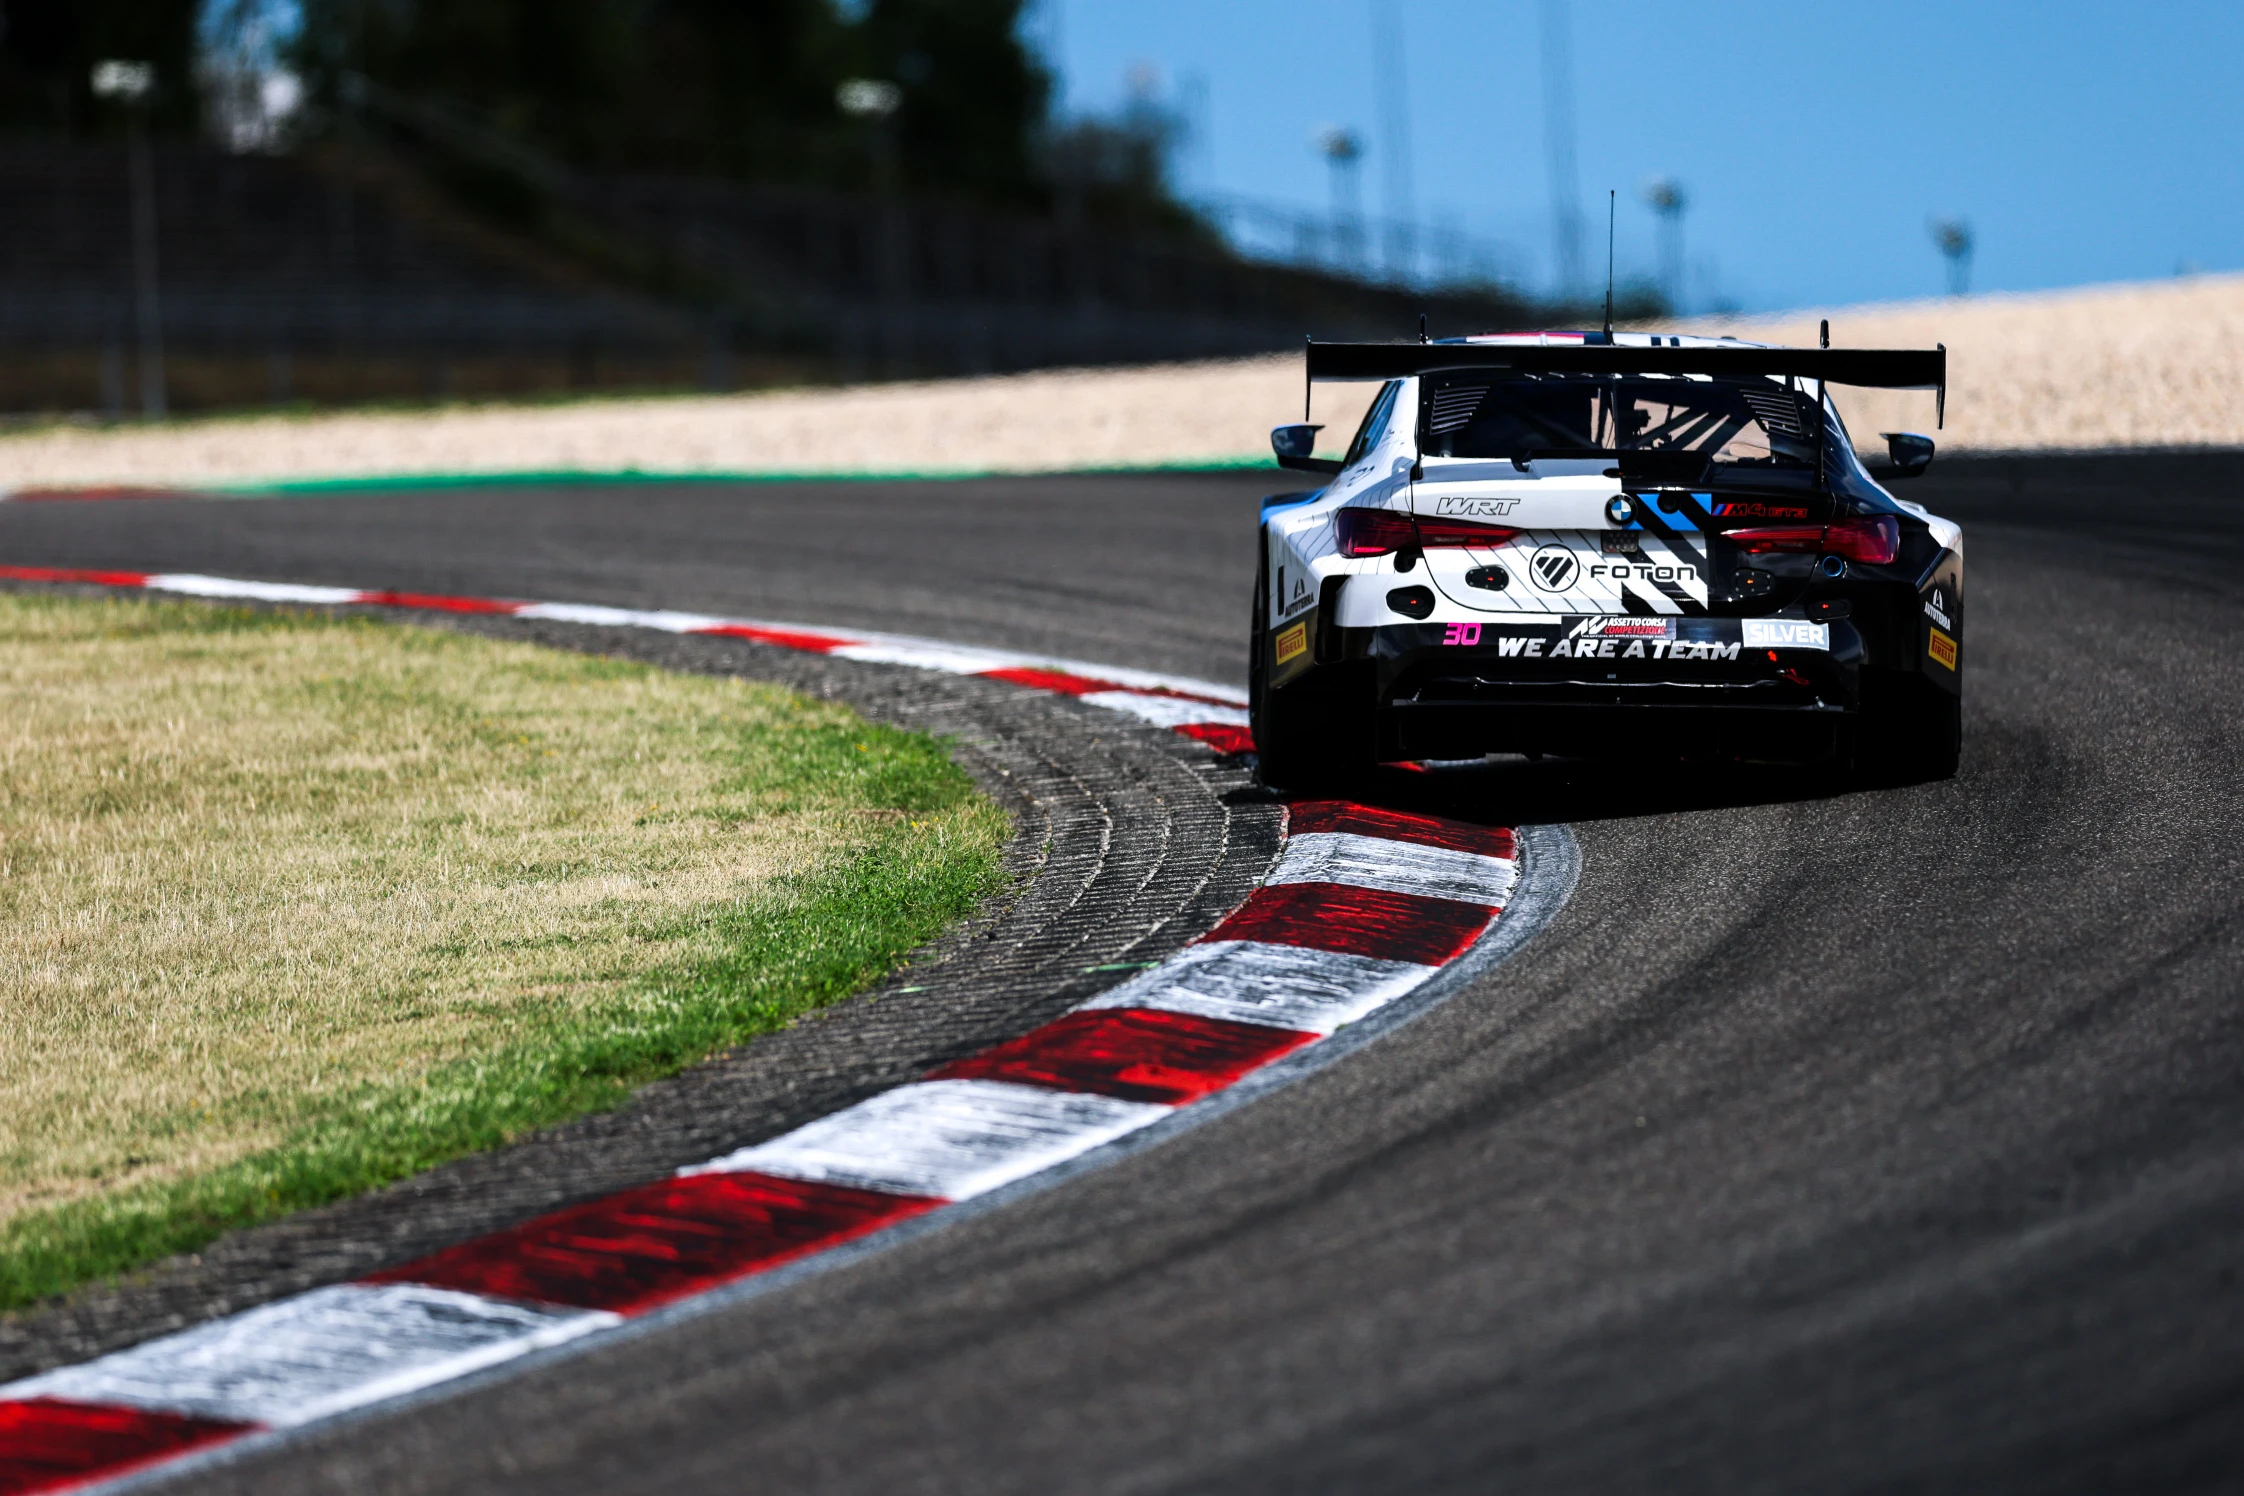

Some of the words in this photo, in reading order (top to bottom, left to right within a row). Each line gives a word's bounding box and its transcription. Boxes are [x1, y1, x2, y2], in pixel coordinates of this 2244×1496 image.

[1436, 497, 1521, 516] WRT
[1768, 507, 1808, 518] GT3
[1590, 564, 1696, 581] FOTON
[1604, 626, 1666, 635] COMPETIZIONE
[1607, 617, 1641, 627] ASSETTO
[1641, 617, 1667, 627] CORSA
[1279, 628, 1304, 659] PIRELLI
[1443, 622, 1482, 646] 30
[1750, 623, 1825, 645] SILVER
[1499, 637, 1547, 657] WE
[1549, 638, 1620, 659] ARE
[1621, 639, 1646, 659] A
[1651, 640, 1742, 660] TEAM
[1931, 634, 1955, 665] PIRELLI
